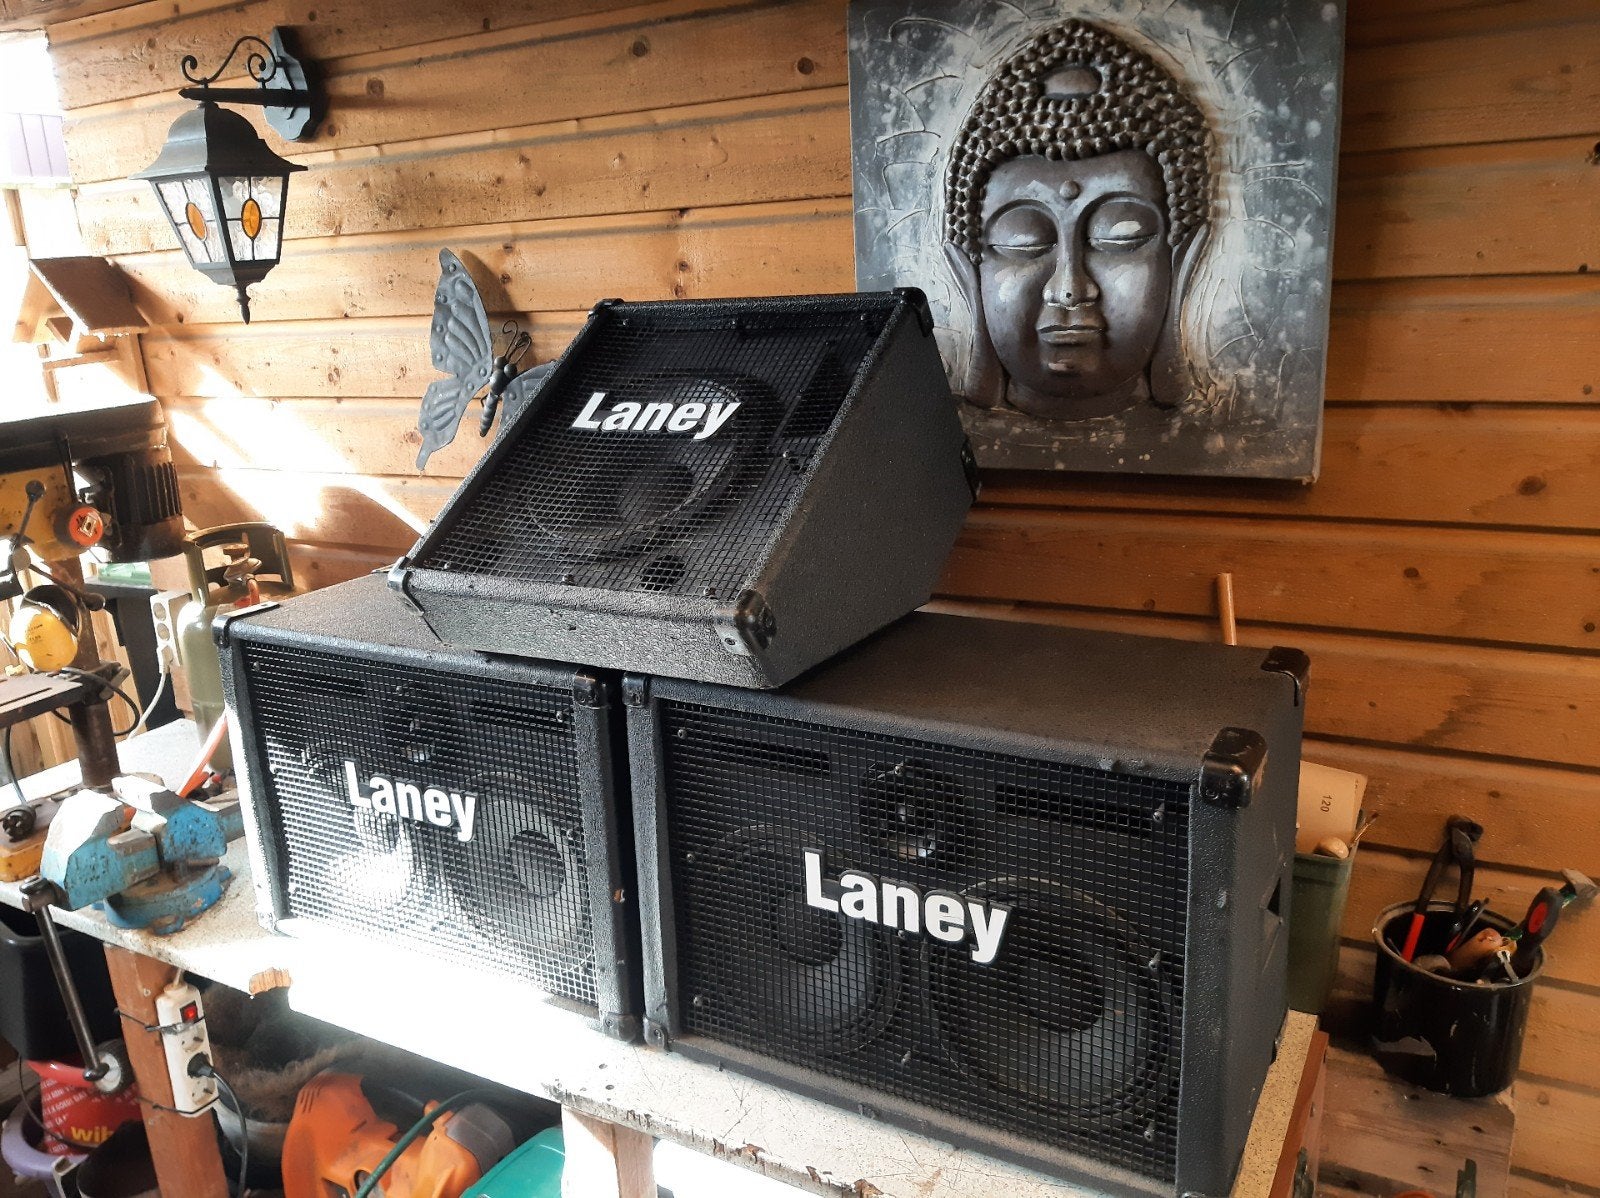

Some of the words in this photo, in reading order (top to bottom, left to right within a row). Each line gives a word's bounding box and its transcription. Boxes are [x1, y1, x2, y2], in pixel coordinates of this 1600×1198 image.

[571, 391, 742, 441] Laney
[343, 759, 477, 843] Laney
[1320, 794, 1333, 813] 120
[803, 849, 1009, 964] Laney
